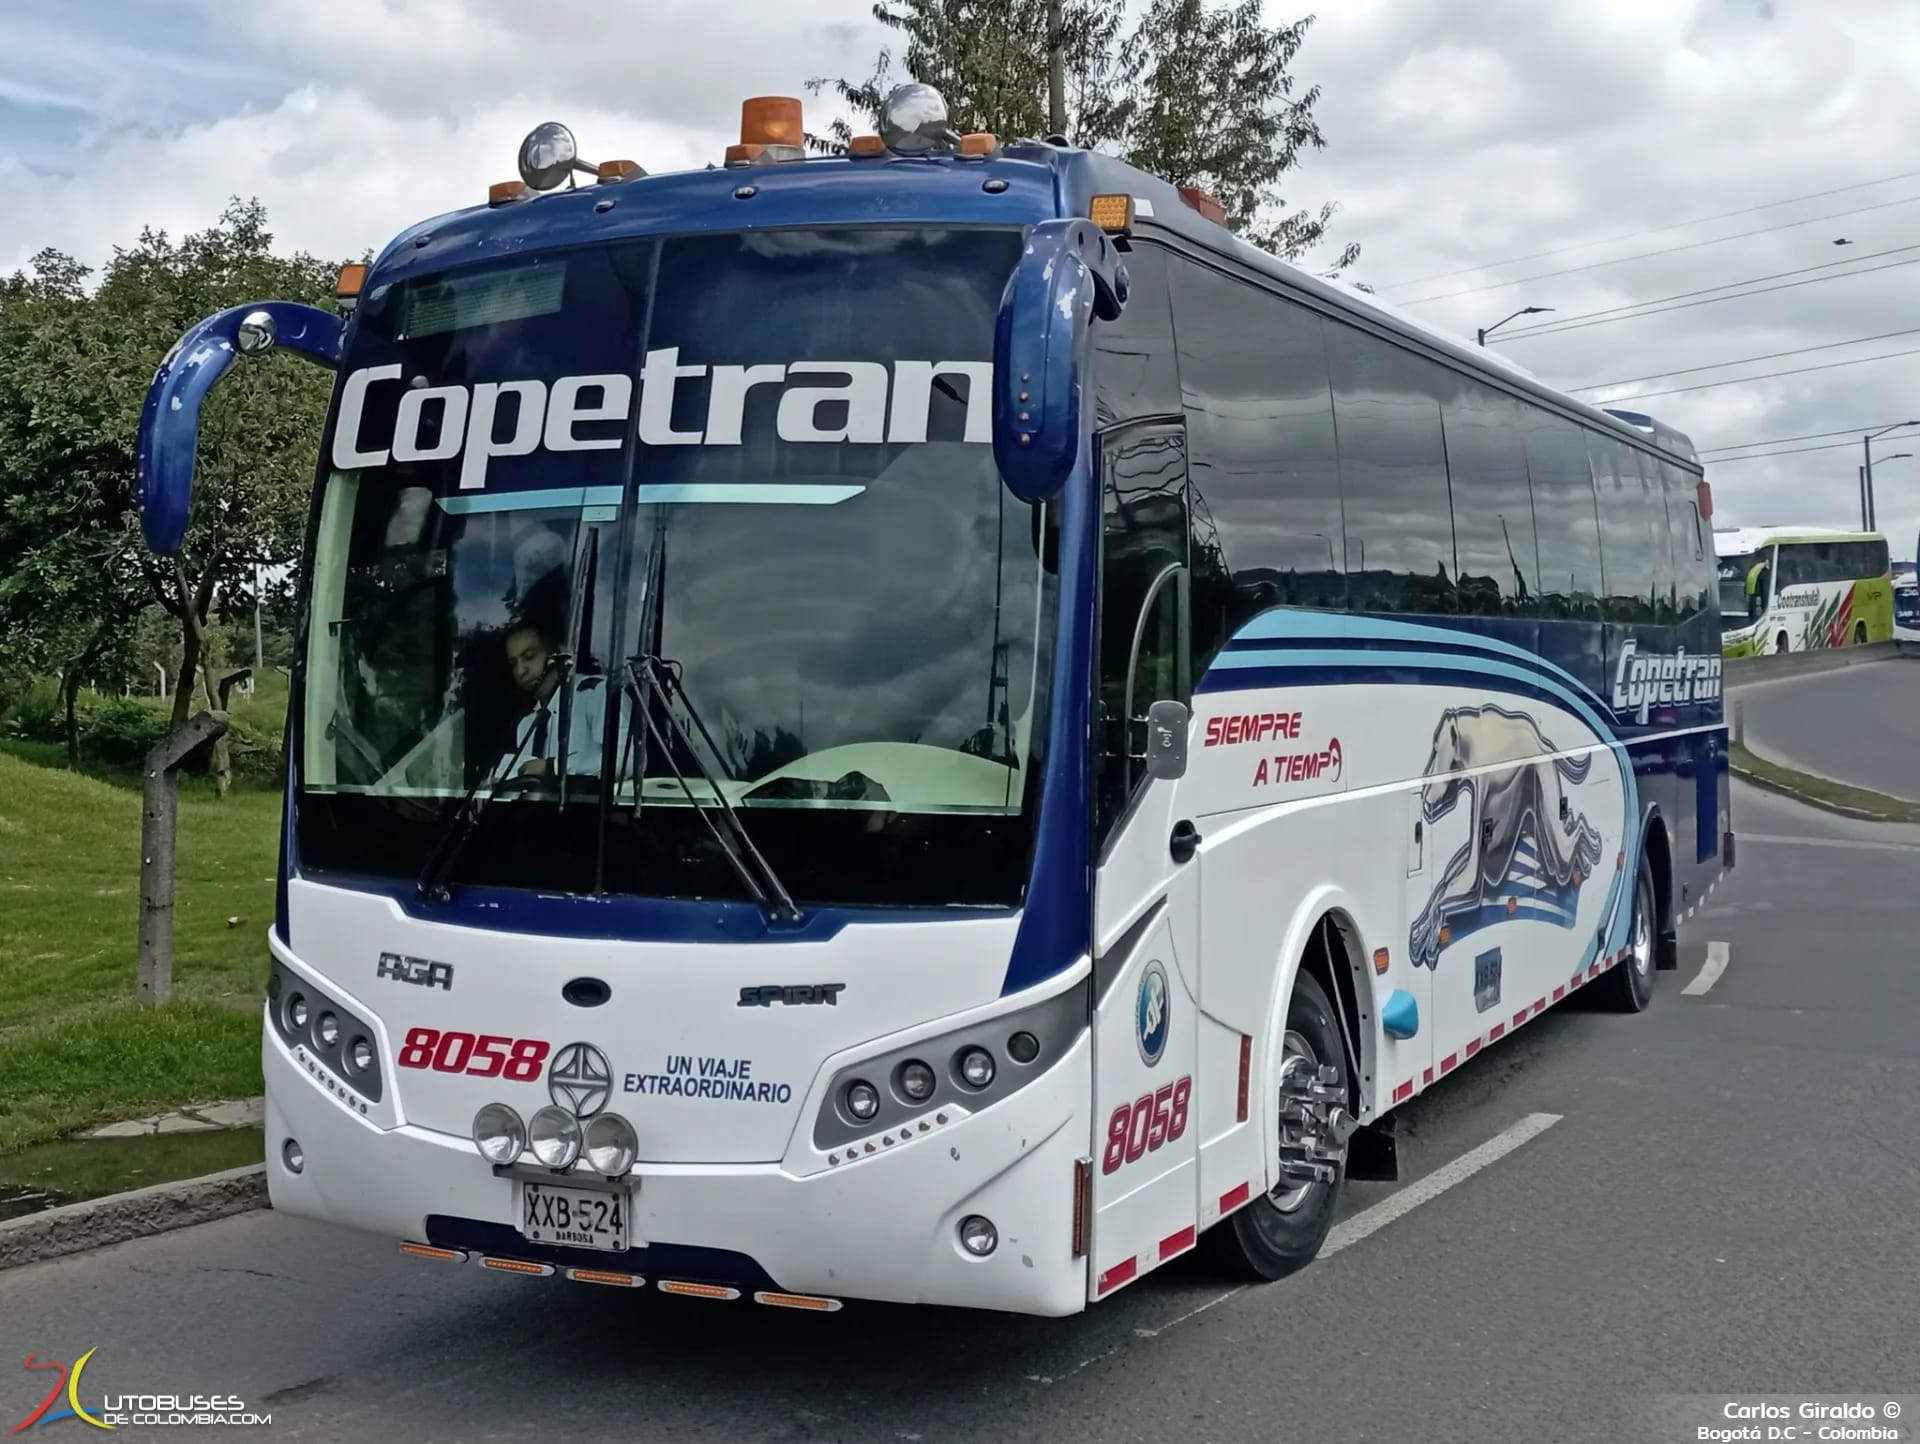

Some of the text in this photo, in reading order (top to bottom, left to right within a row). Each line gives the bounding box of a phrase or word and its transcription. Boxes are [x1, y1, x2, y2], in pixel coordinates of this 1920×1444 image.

[332, 346, 993, 489] Copetran
[1613, 639, 1721, 724] Copetran
[1204, 712, 1302, 747] SIEMPRE
[1252, 758, 1268, 787] A
[377, 952, 455, 991] AGA
[737, 983, 846, 1008] SPIRIT
[398, 1027, 551, 1082] 8058
[666, 1055, 751, 1080] UN VIAJE
[623, 1073, 792, 1104] EXTRAORDINARIO
[1102, 1074, 1192, 1176] 8058
[556, 1231, 594, 1244] BARBOSA
